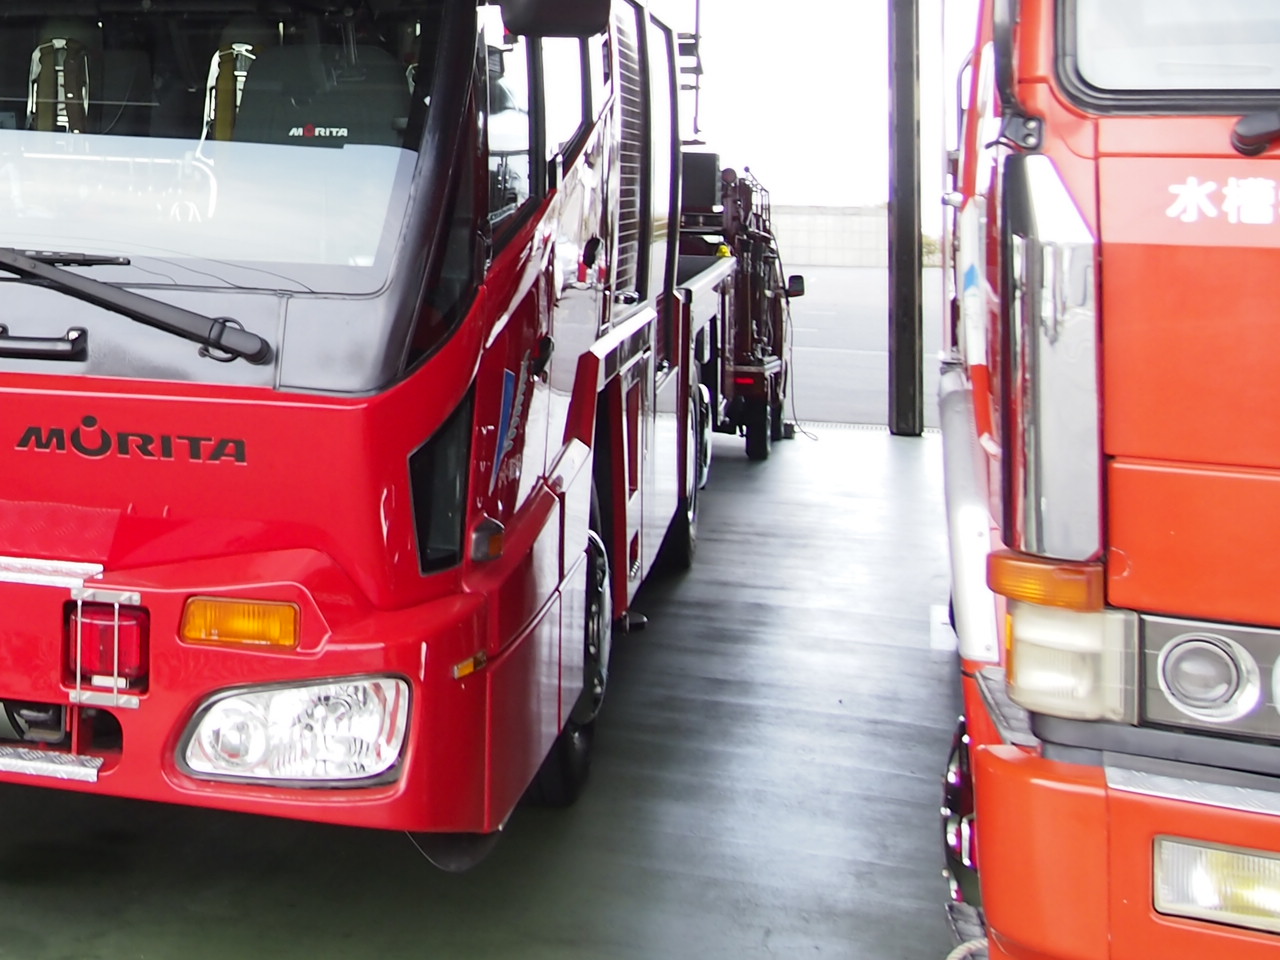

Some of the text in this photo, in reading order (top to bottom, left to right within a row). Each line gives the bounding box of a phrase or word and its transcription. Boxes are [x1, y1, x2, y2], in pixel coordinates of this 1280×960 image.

[288, 124, 348, 137] MORITA
[1165, 176, 1280, 224] 水槽
[14, 415, 247, 466] MORITA
